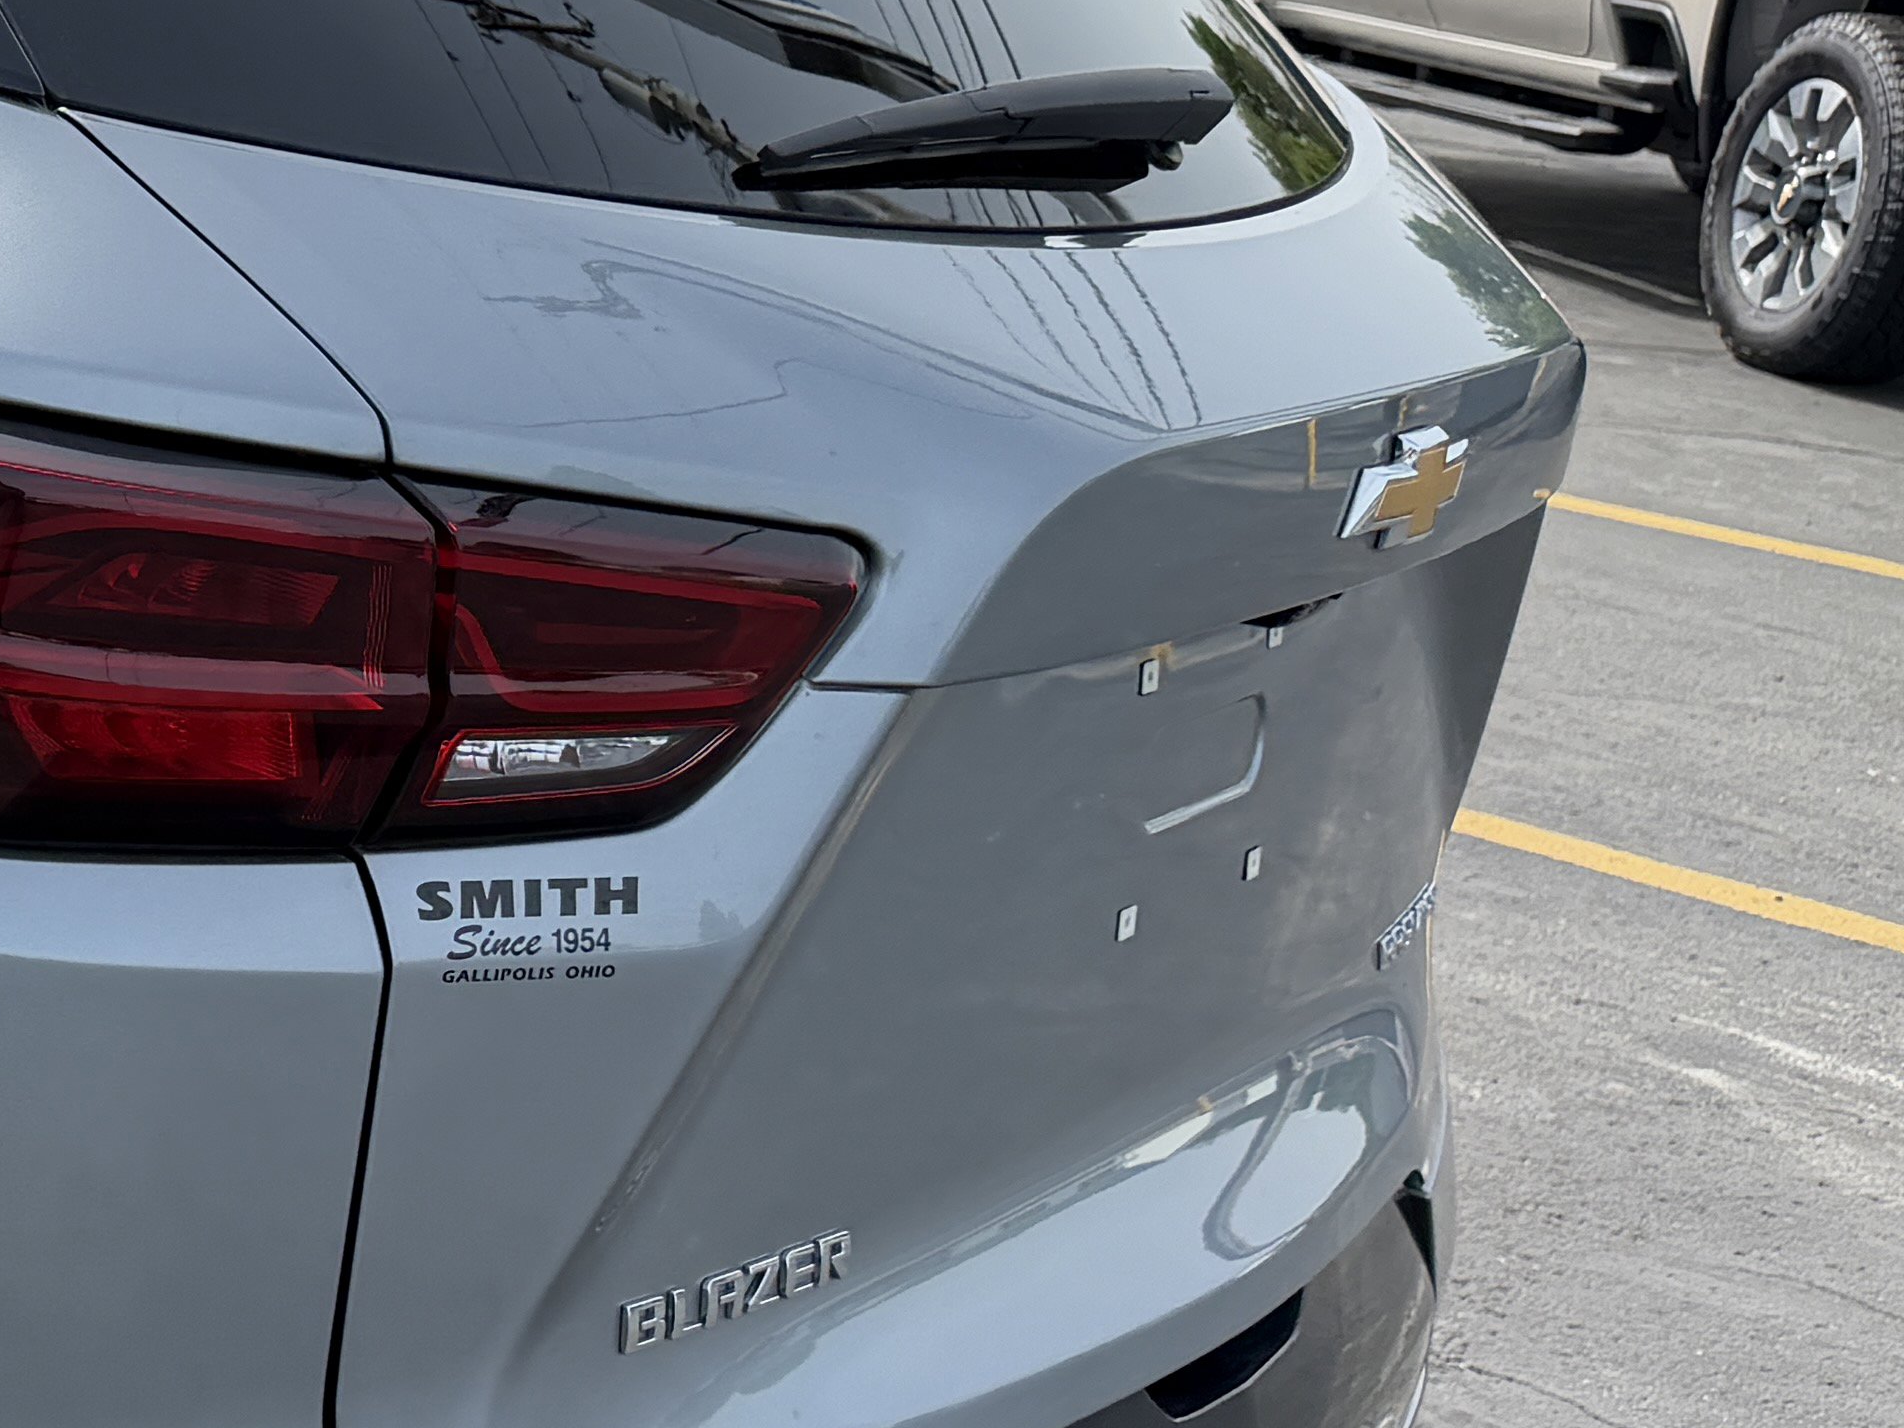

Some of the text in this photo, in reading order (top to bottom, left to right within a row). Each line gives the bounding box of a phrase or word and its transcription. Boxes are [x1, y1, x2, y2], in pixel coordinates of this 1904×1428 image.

[416, 876, 640, 921] SMITH
[446, 925, 612, 960] Since 1954
[441, 964, 616, 984] GALLIPOLIS OHIO
[617, 1228, 853, 1355] BLAZER
